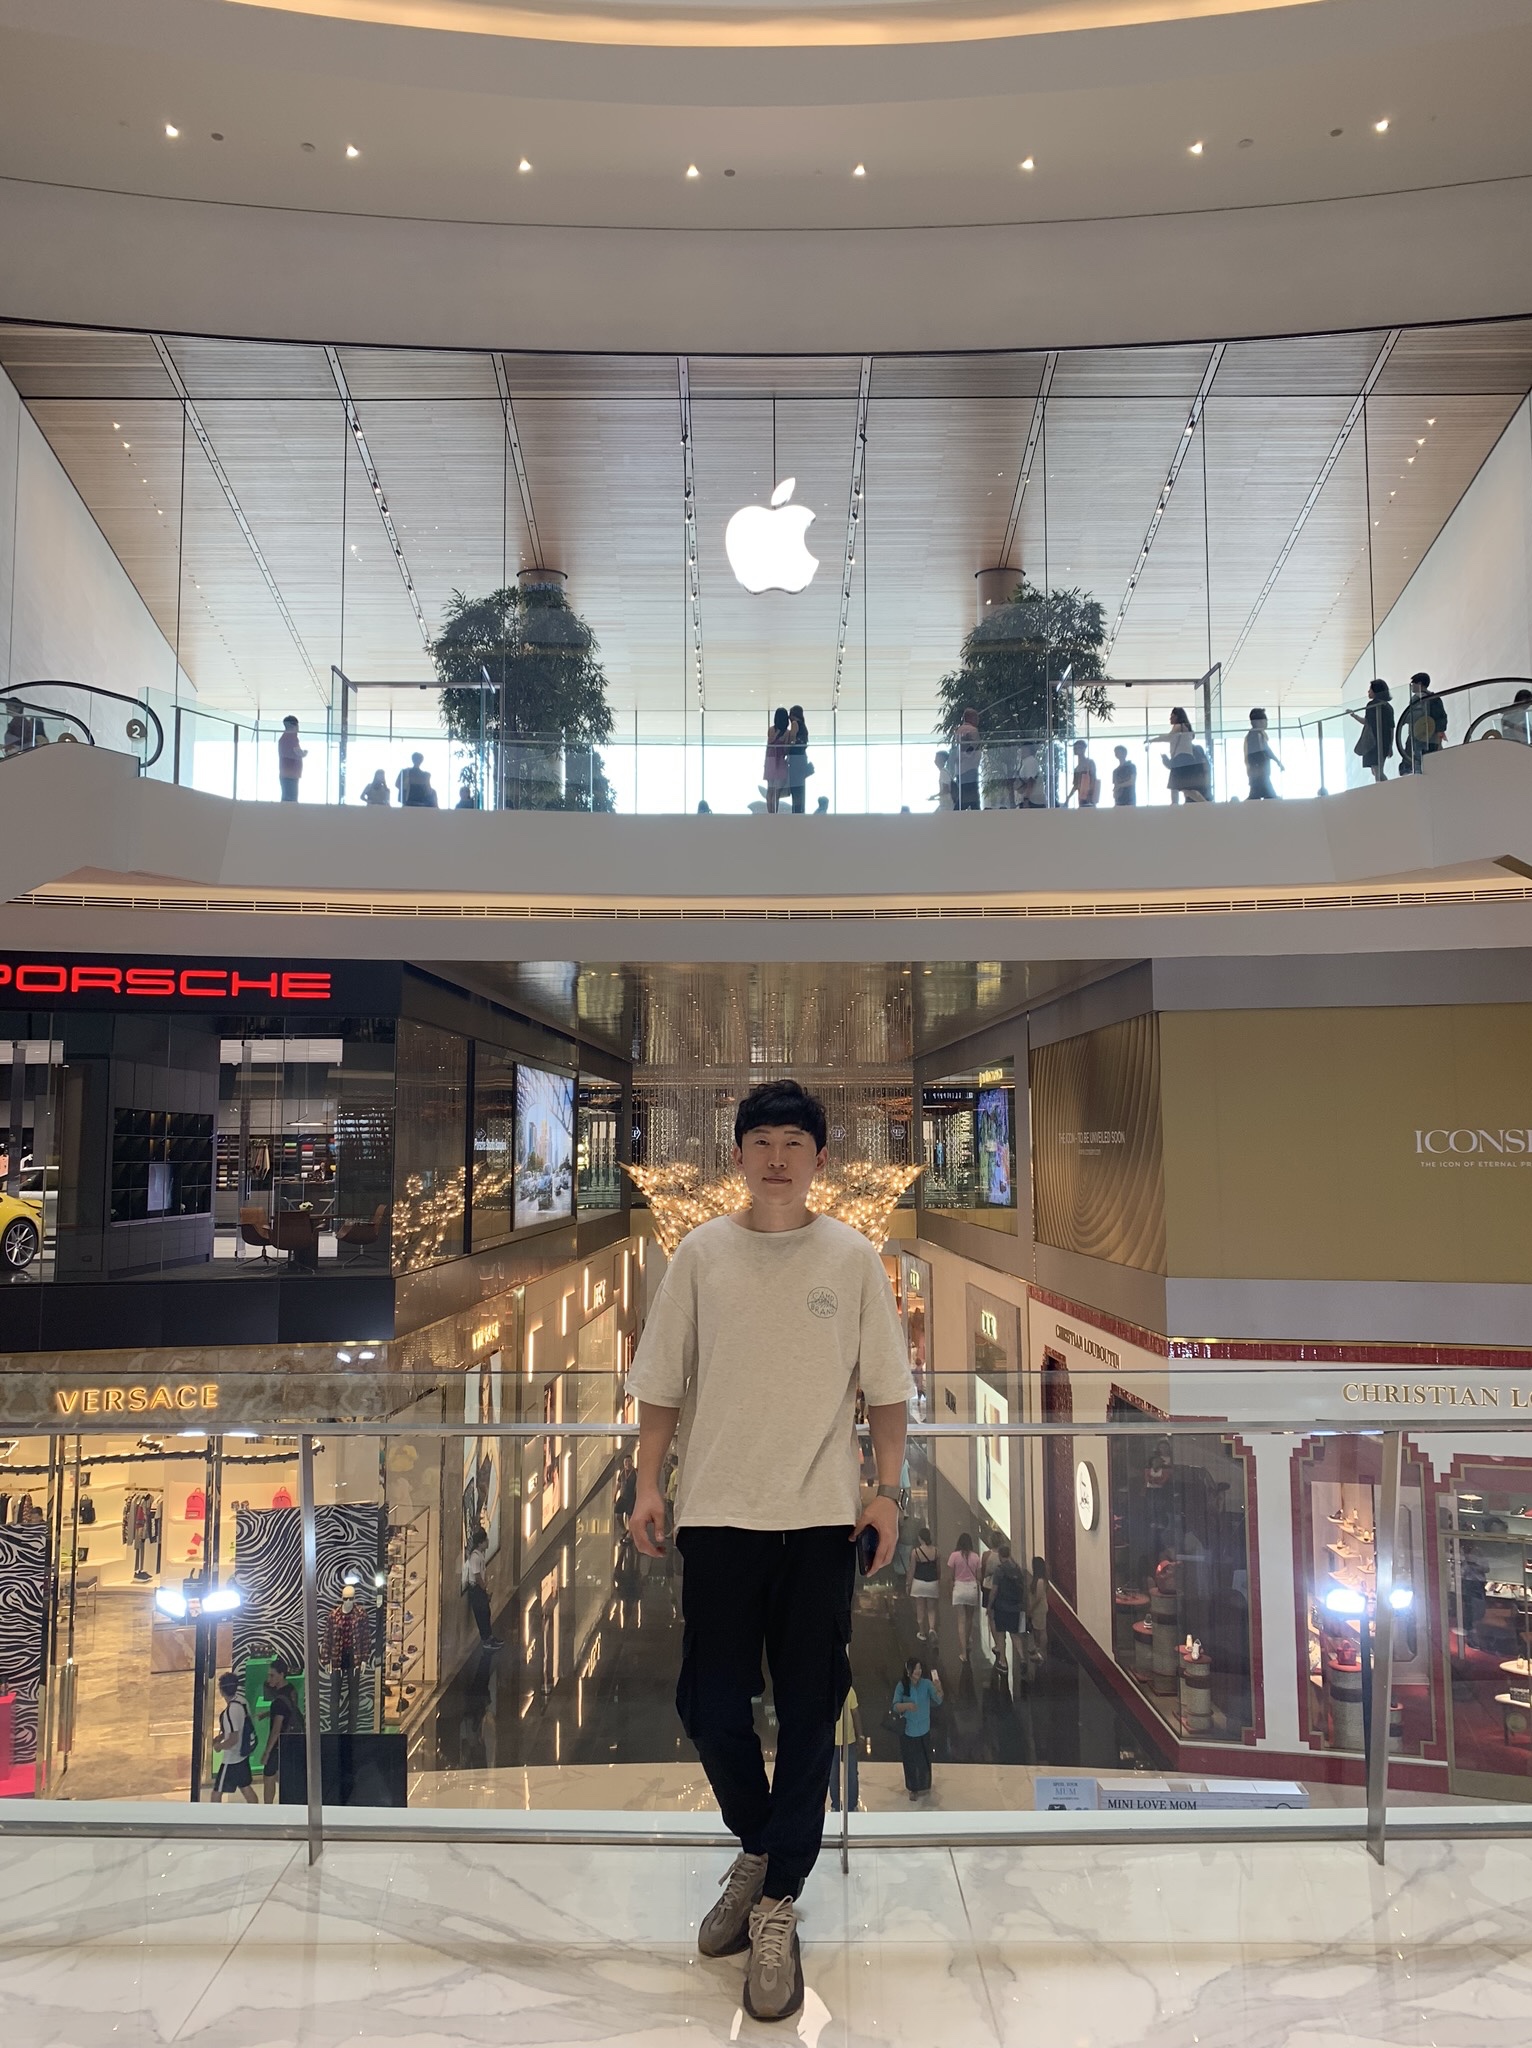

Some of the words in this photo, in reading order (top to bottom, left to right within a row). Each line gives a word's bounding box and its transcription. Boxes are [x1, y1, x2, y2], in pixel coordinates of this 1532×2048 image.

[131, 725, 141, 738] 2
[0, 964, 332, 999] ORSCHE
[56, 1384, 219, 1415] VERSACE
[1342, 1382, 1500, 1407] CHRISTIAN
[1510, 1387, 1532, 1408] L
[1108, 1799, 1133, 1809] MINI
[1137, 1799, 1167, 1810] LOVE
[1169, 1800, 1197, 1810] MOM
